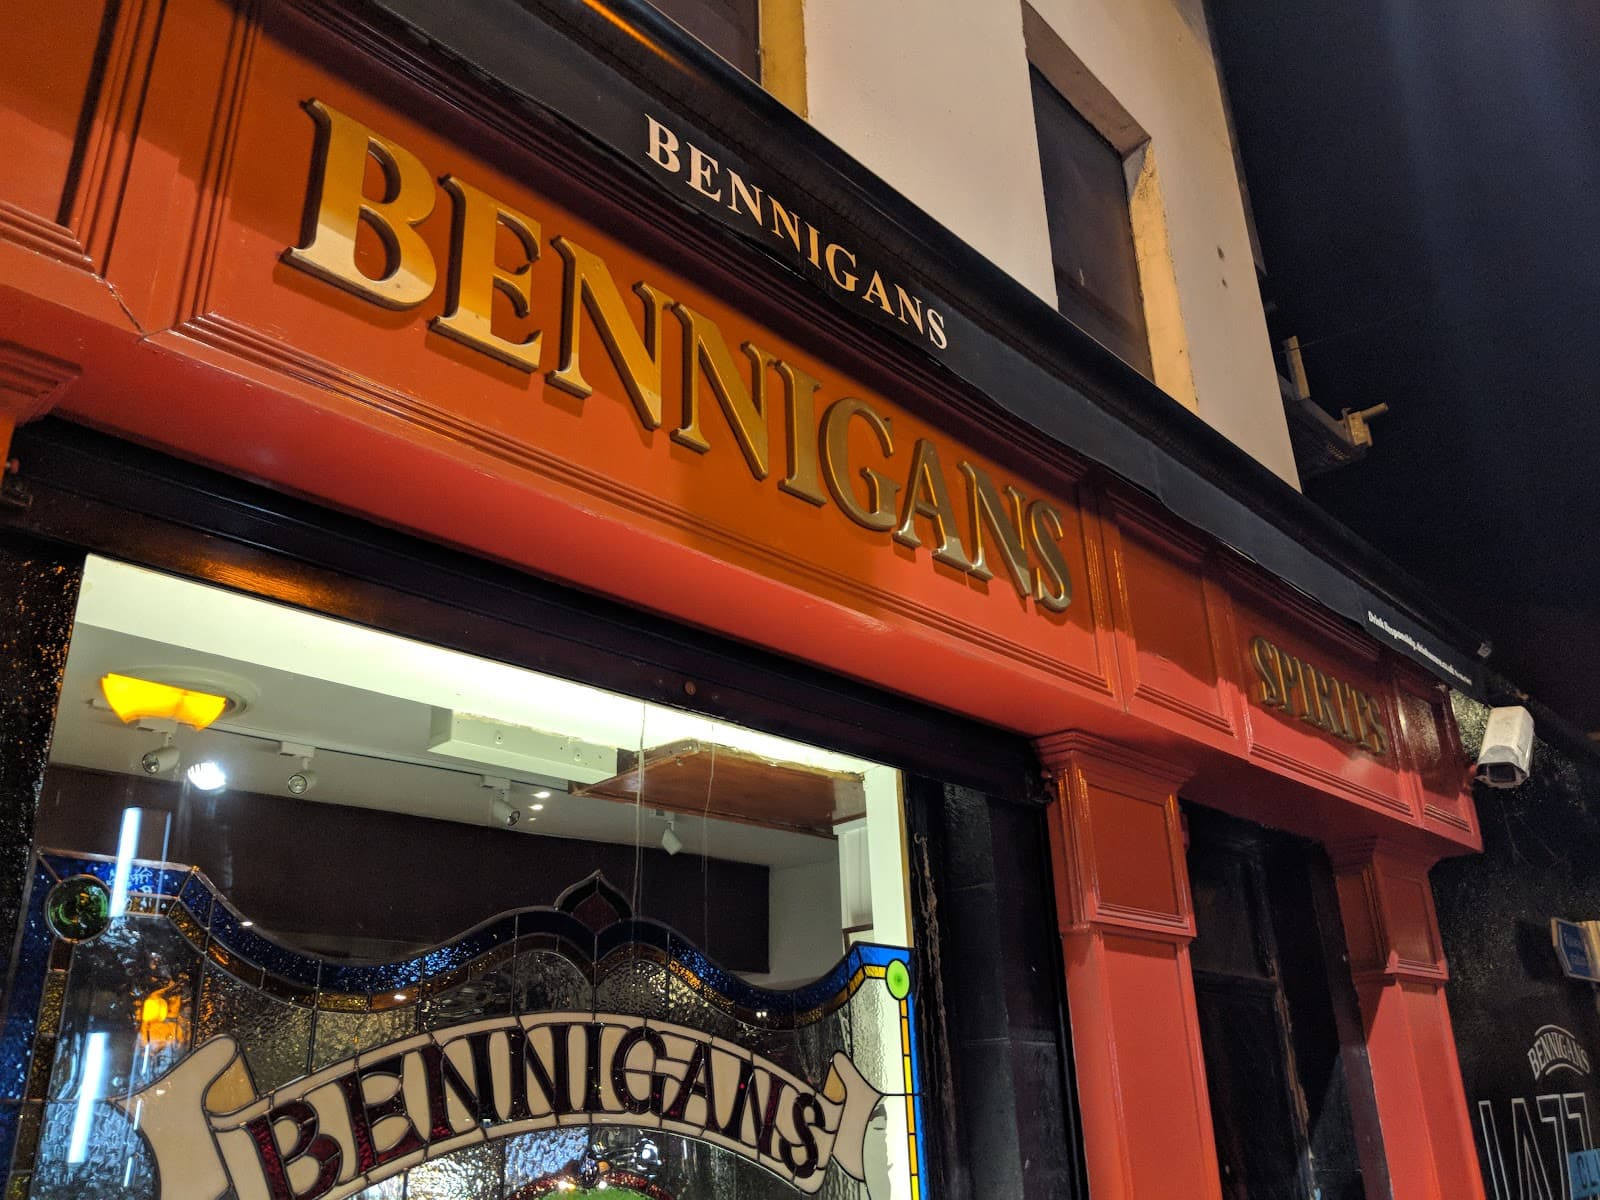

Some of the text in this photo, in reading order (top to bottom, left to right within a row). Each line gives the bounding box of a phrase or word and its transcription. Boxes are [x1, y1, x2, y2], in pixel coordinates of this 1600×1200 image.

[645, 114, 948, 350] BENNIGANS
[283, 97, 1072, 614] BENNIGANS
[1253, 637, 1388, 755] SPIRITS
[247, 1024, 828, 1200] BENNIGANS
[1527, 1032, 1591, 1080] BENNIGANS
